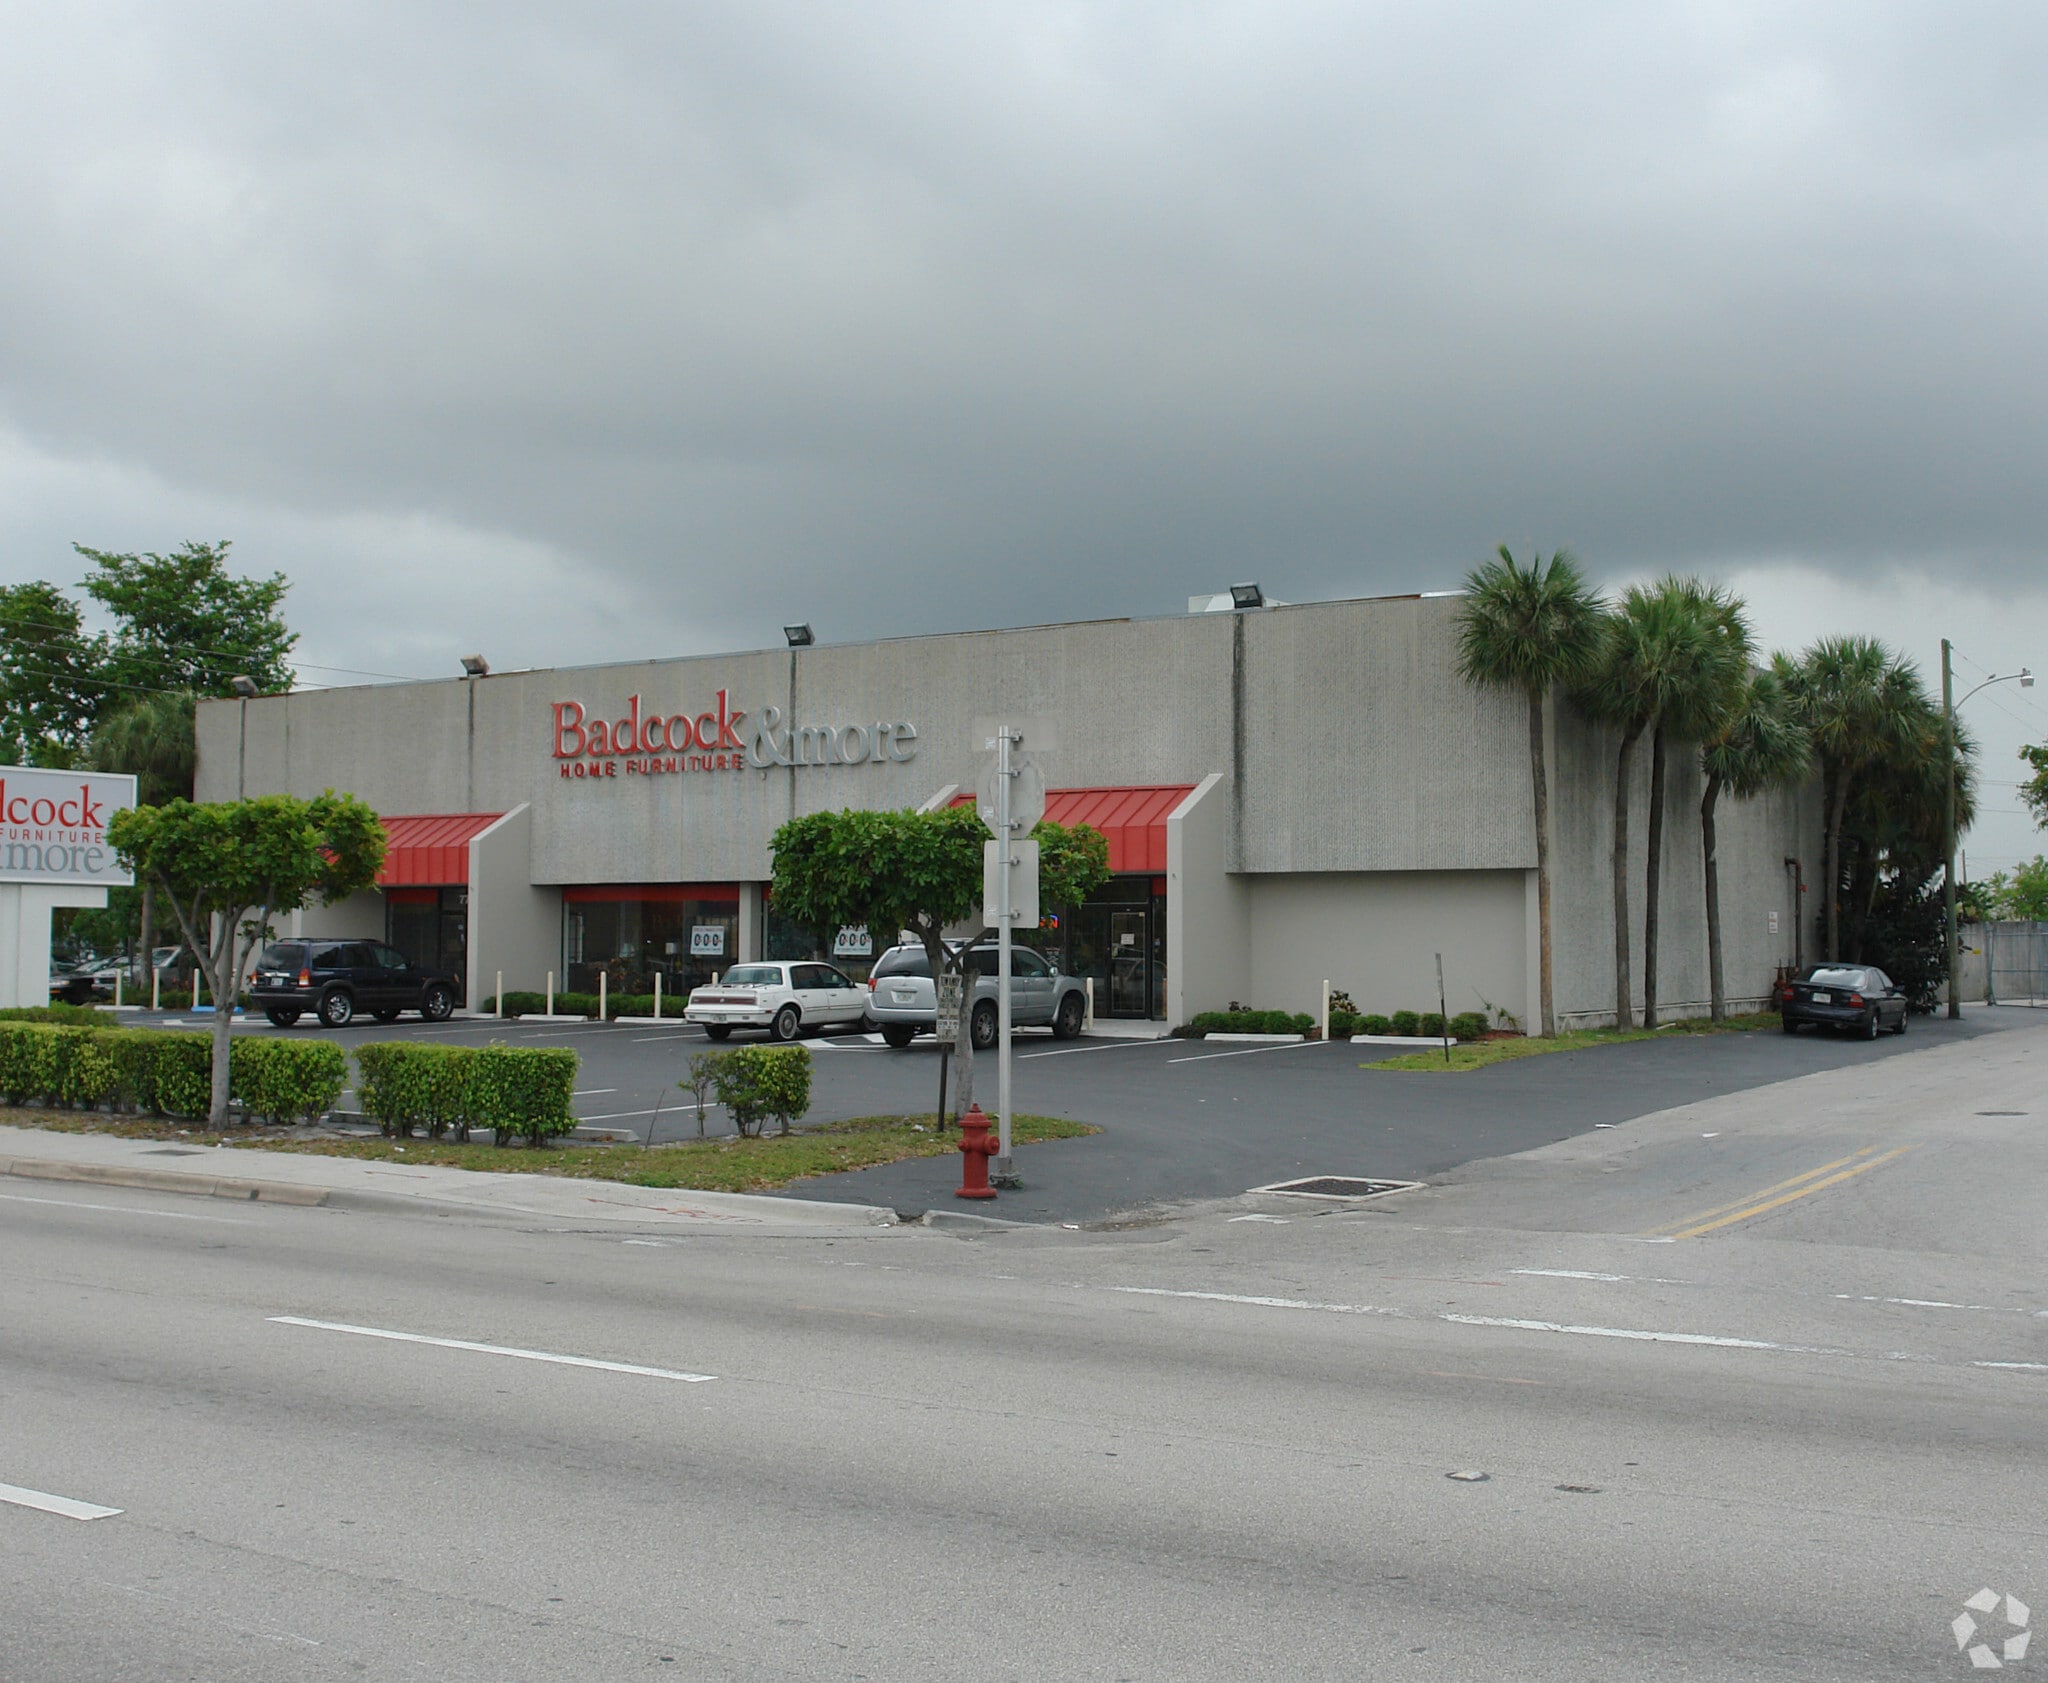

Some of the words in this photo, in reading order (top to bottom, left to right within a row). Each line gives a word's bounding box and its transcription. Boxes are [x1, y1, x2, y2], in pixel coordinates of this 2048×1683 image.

[550, 689, 746, 758] Badcock
[560, 760, 616, 778] HOME
[626, 753, 744, 775] FURNITURE
[0, 842, 104, 873] more
